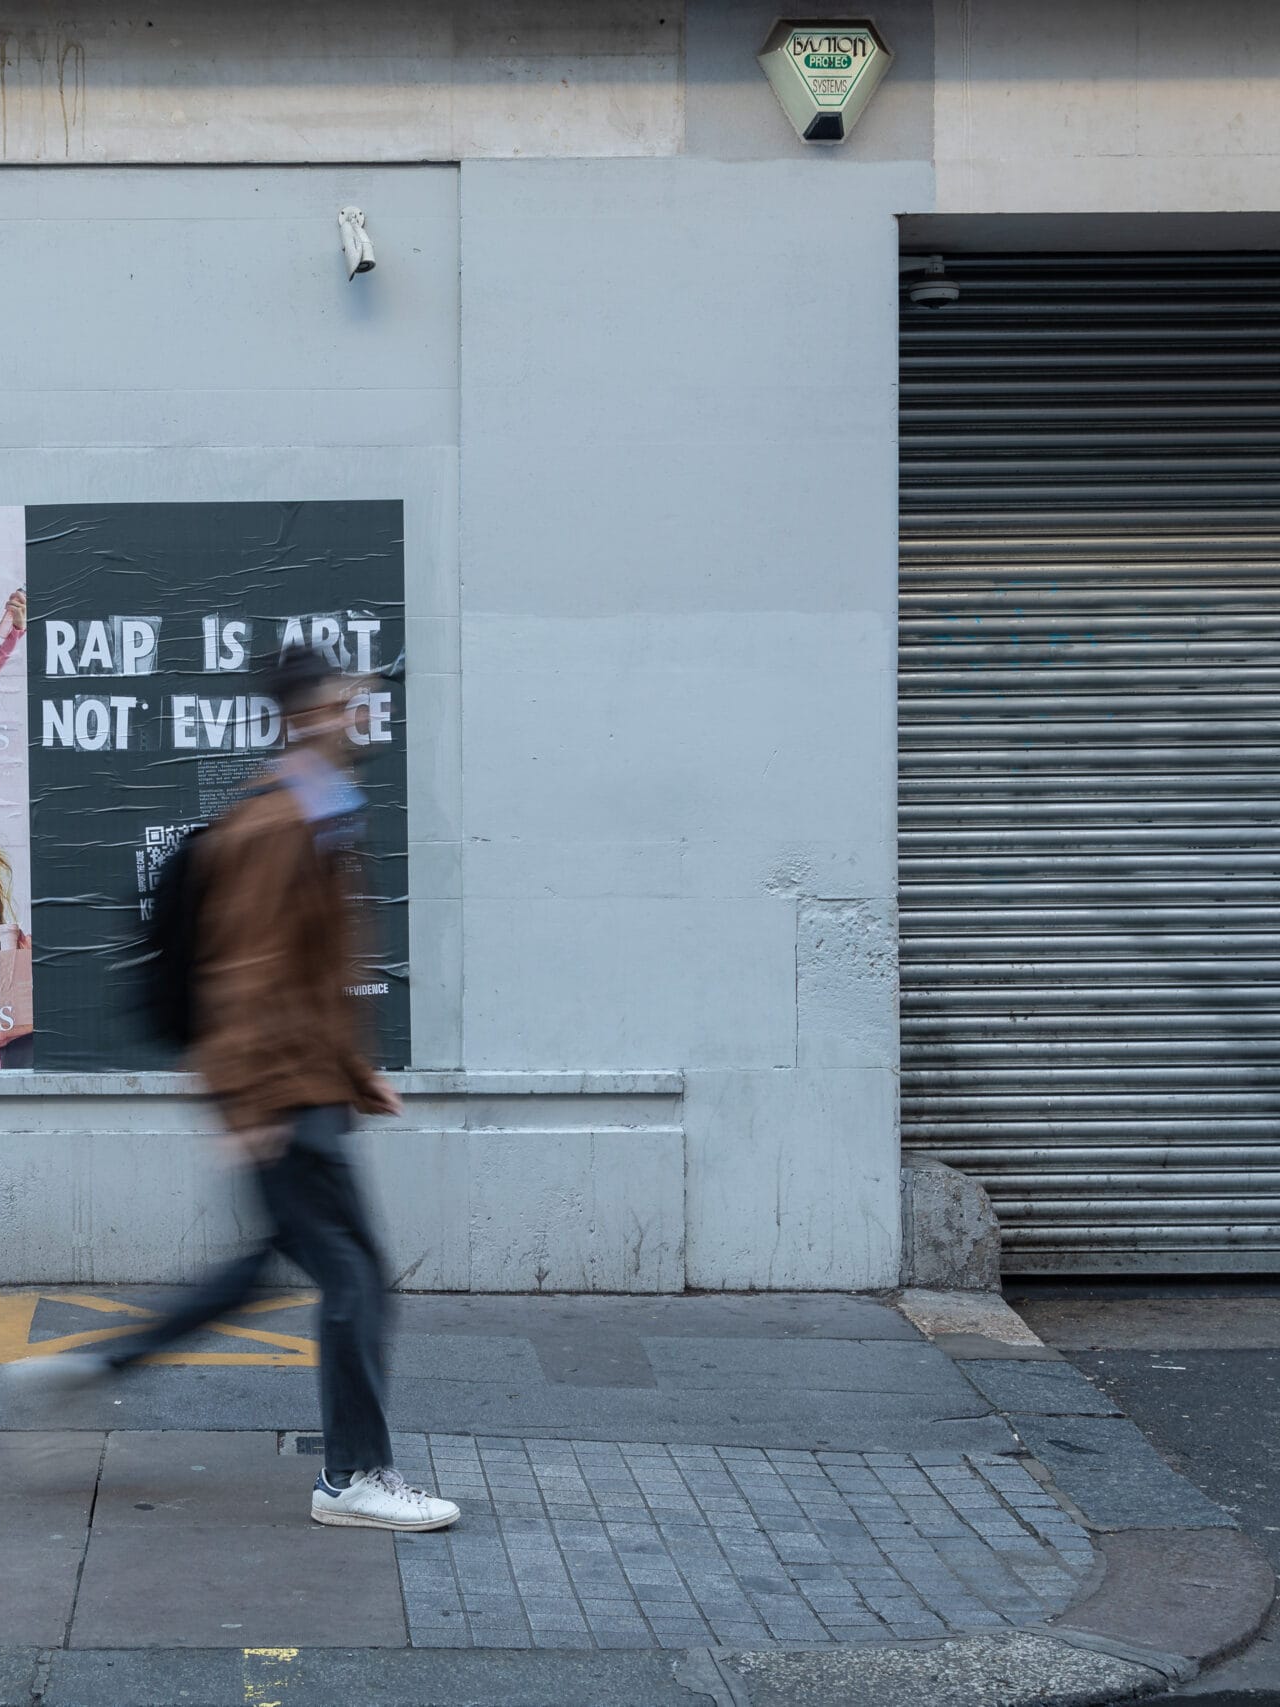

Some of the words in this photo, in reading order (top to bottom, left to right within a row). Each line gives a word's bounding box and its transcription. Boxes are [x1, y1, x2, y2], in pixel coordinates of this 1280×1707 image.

[812, 79, 847, 93] SYSTEMS
[45, 620, 155, 675] RAP
[203, 618, 246, 670] IS
[278, 617, 381, 672] ART
[42, 696, 137, 750] NOT
[173, 691, 392, 748] EVIDCE
